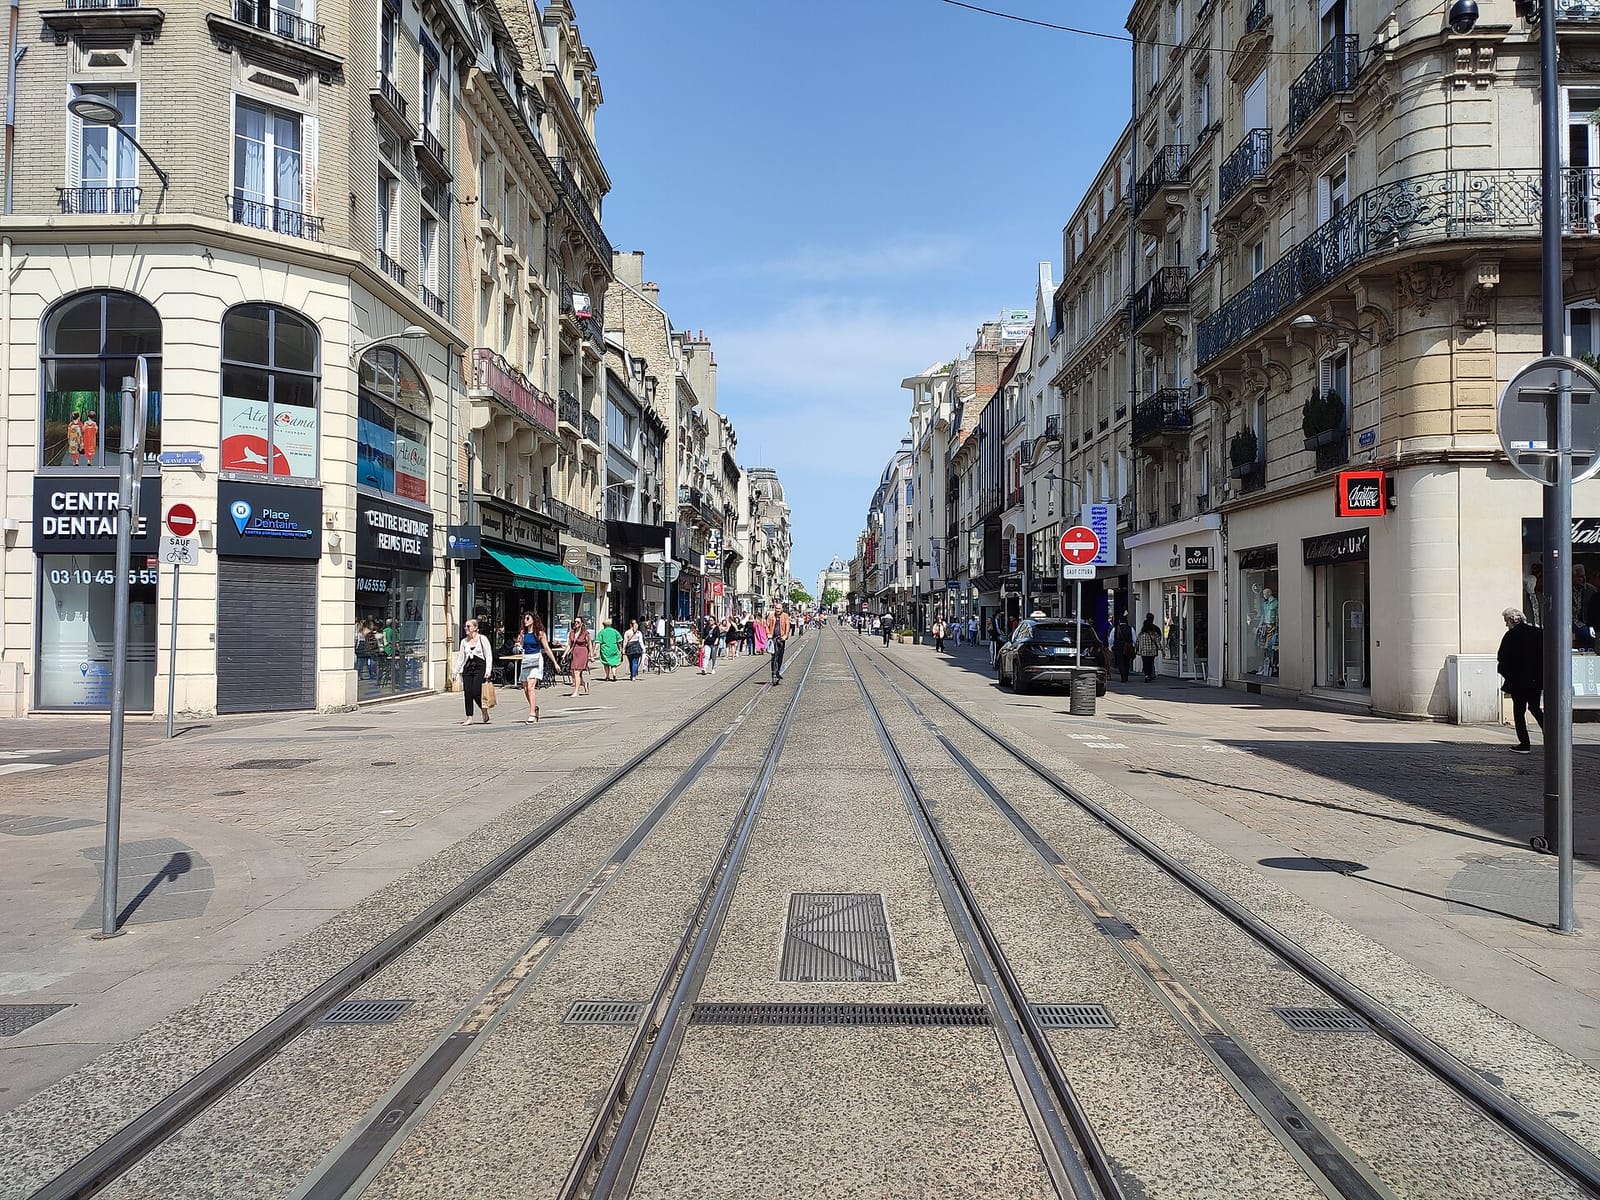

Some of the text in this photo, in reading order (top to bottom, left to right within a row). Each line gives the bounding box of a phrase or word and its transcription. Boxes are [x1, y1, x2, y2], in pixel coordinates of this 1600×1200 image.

[51, 492, 119, 510] CENTR
[263, 509, 290, 520] Place
[43, 516, 147, 534] DENTAIE
[254, 518, 298, 529] Dentaire
[367, 510, 429, 537] CENTRE DENTAIRE
[170, 538, 190, 546] SAUF
[378, 532, 421, 555] REIMS VESLE
[1187, 556, 1207, 564] avril
[51, 570, 70, 584] 03
[73, 570, 91, 584] 10
[95, 570, 114, 584] 45
[140, 570, 158, 584] 55
[364, 579, 371, 591] 45
[371, 580, 379, 591] 55
